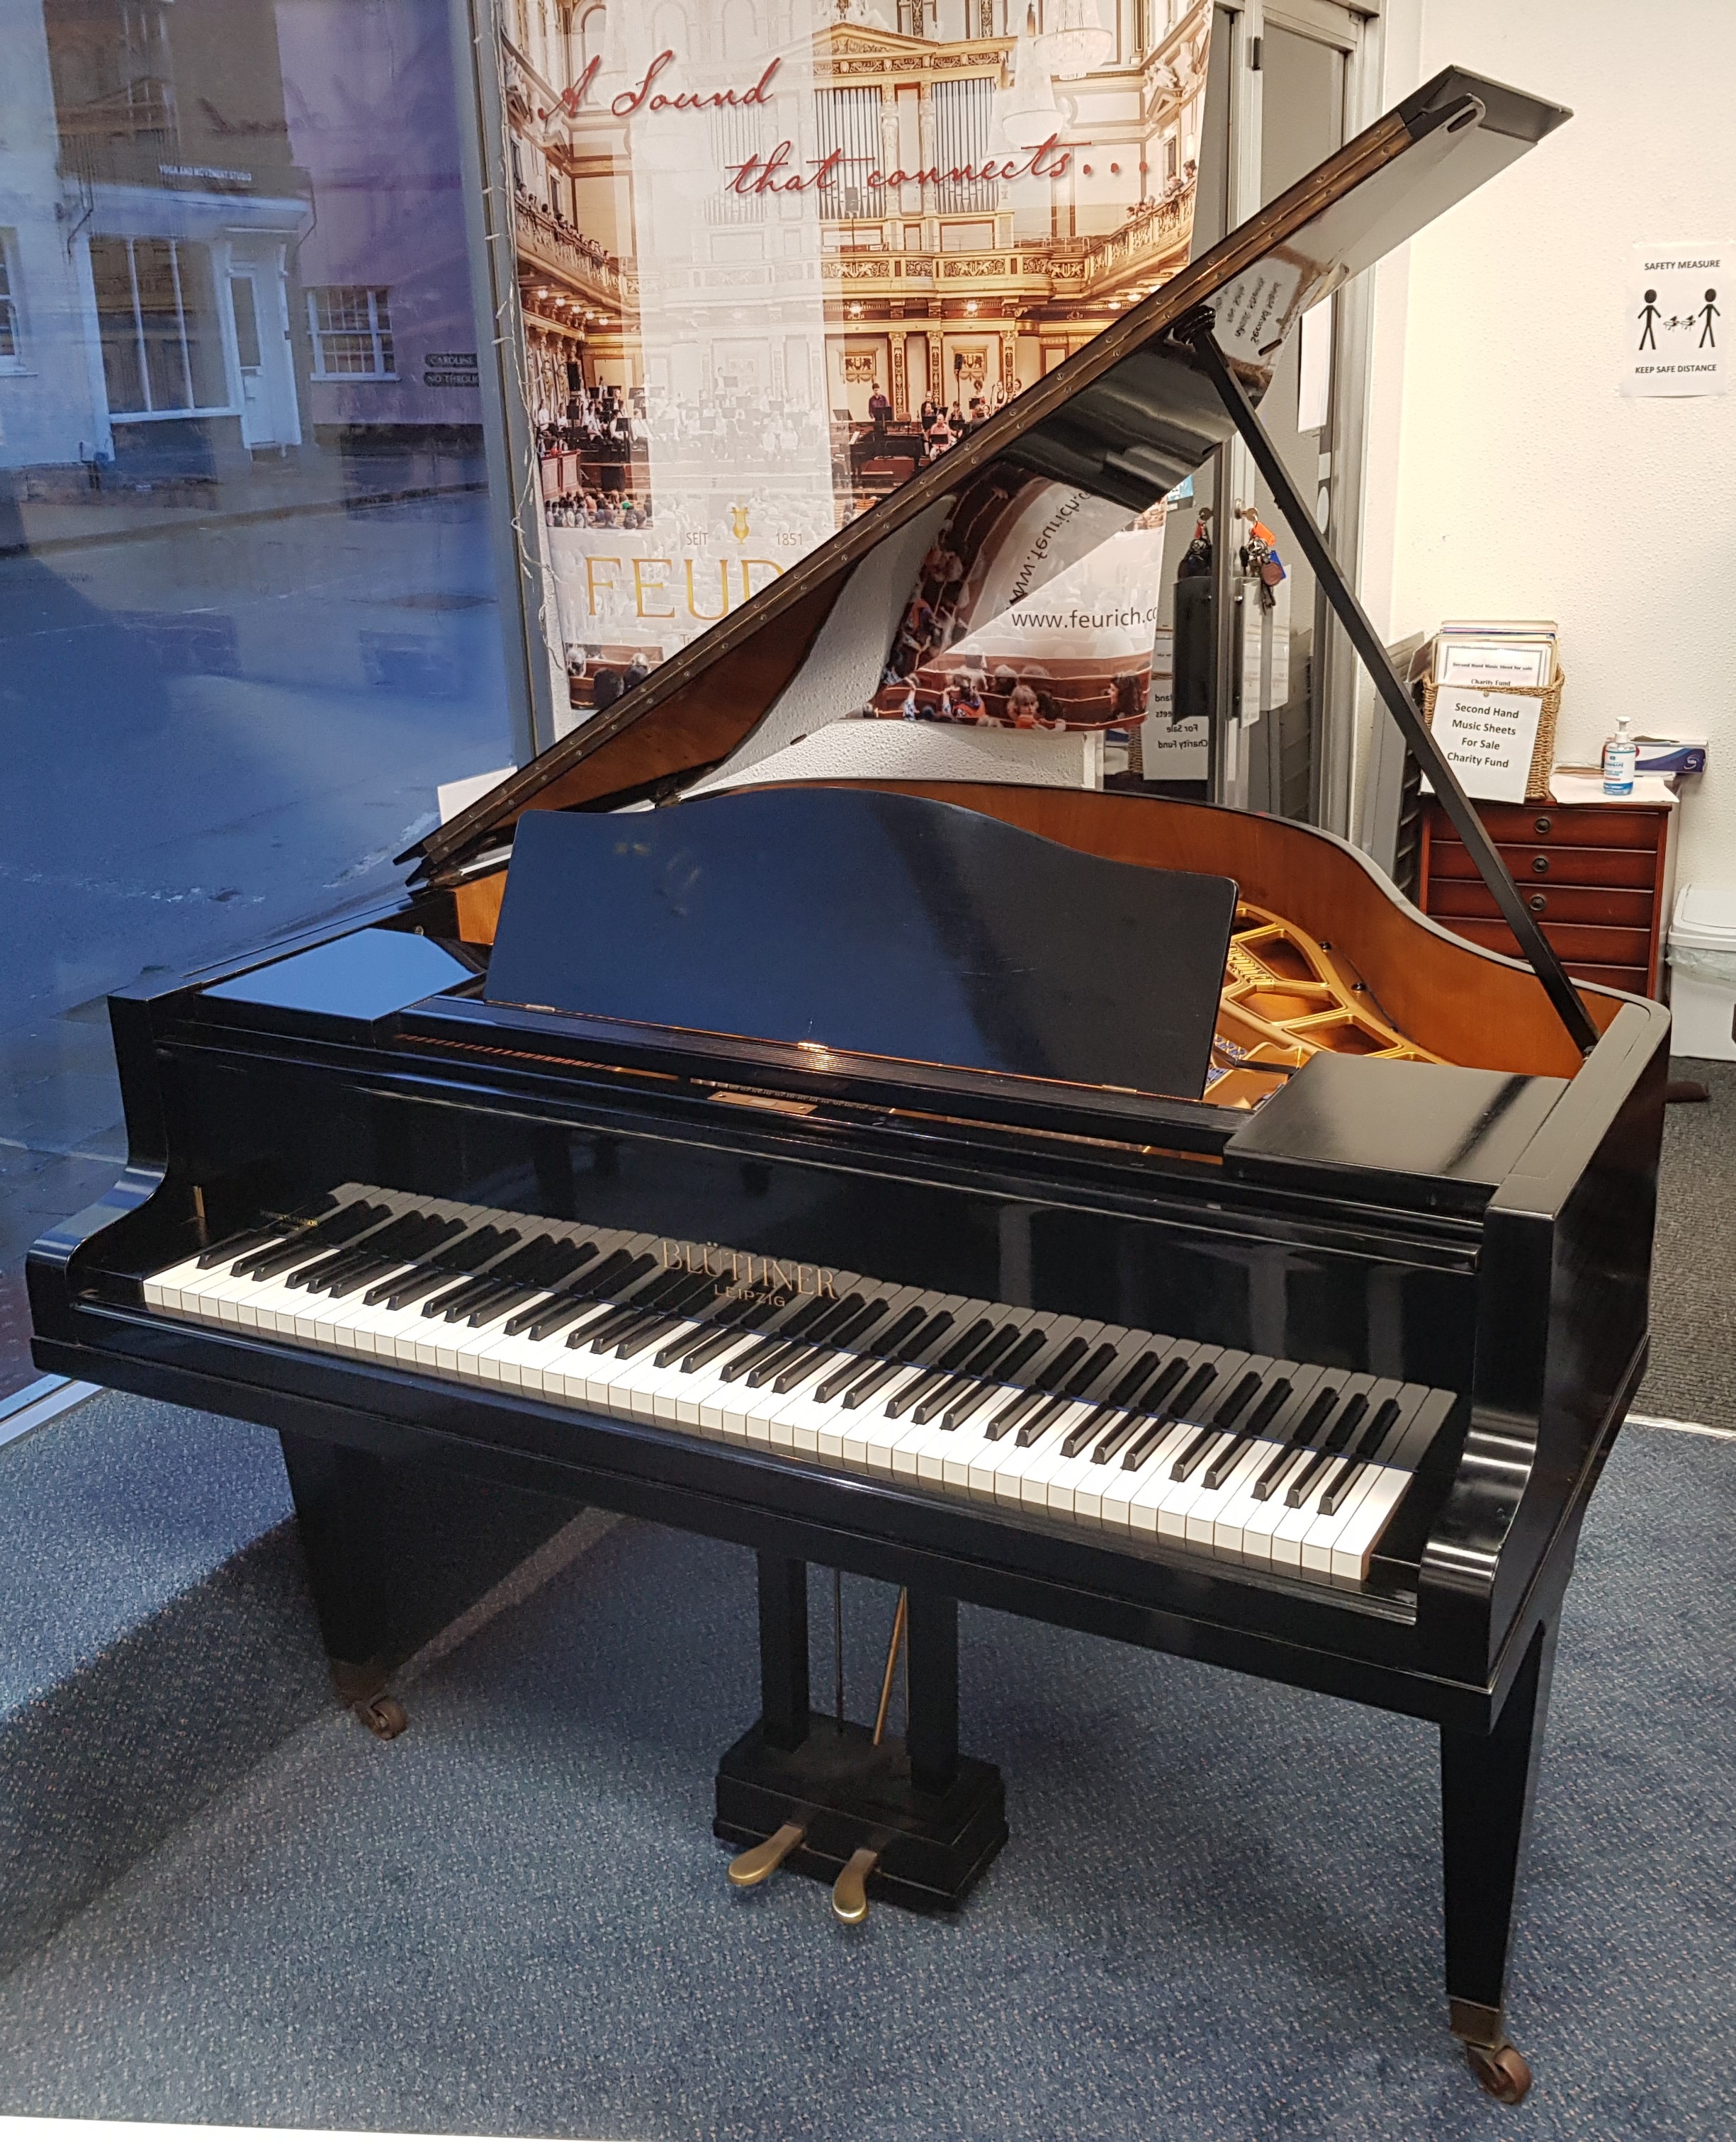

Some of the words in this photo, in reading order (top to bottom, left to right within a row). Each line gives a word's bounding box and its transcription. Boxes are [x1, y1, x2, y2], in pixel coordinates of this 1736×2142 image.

[611, 50, 781, 116] Sound
[725, 140, 875, 194] that
[1645, 261, 1676, 270] SAFETY
[1677, 260, 1721, 269] MEASURE
[427, 374, 442, 383] NO
[686, 532, 709, 546] SEIT
[775, 533, 804, 546] 1851
[1455, 702, 1491, 715] Second
[1493, 707, 1519, 718] Hand
[1452, 719, 1481, 731] Music
[1482, 723, 1516, 735] Sheets
[1461, 737, 1477, 747] For
[1479, 740, 1500, 750] Sale
[1447, 752, 1482, 766] Charity
[1484, 757, 1509, 768] Fund
[662, 1240, 839, 1300] BLÜTHNER
[714, 1284, 786, 1307] LEIPZIG
